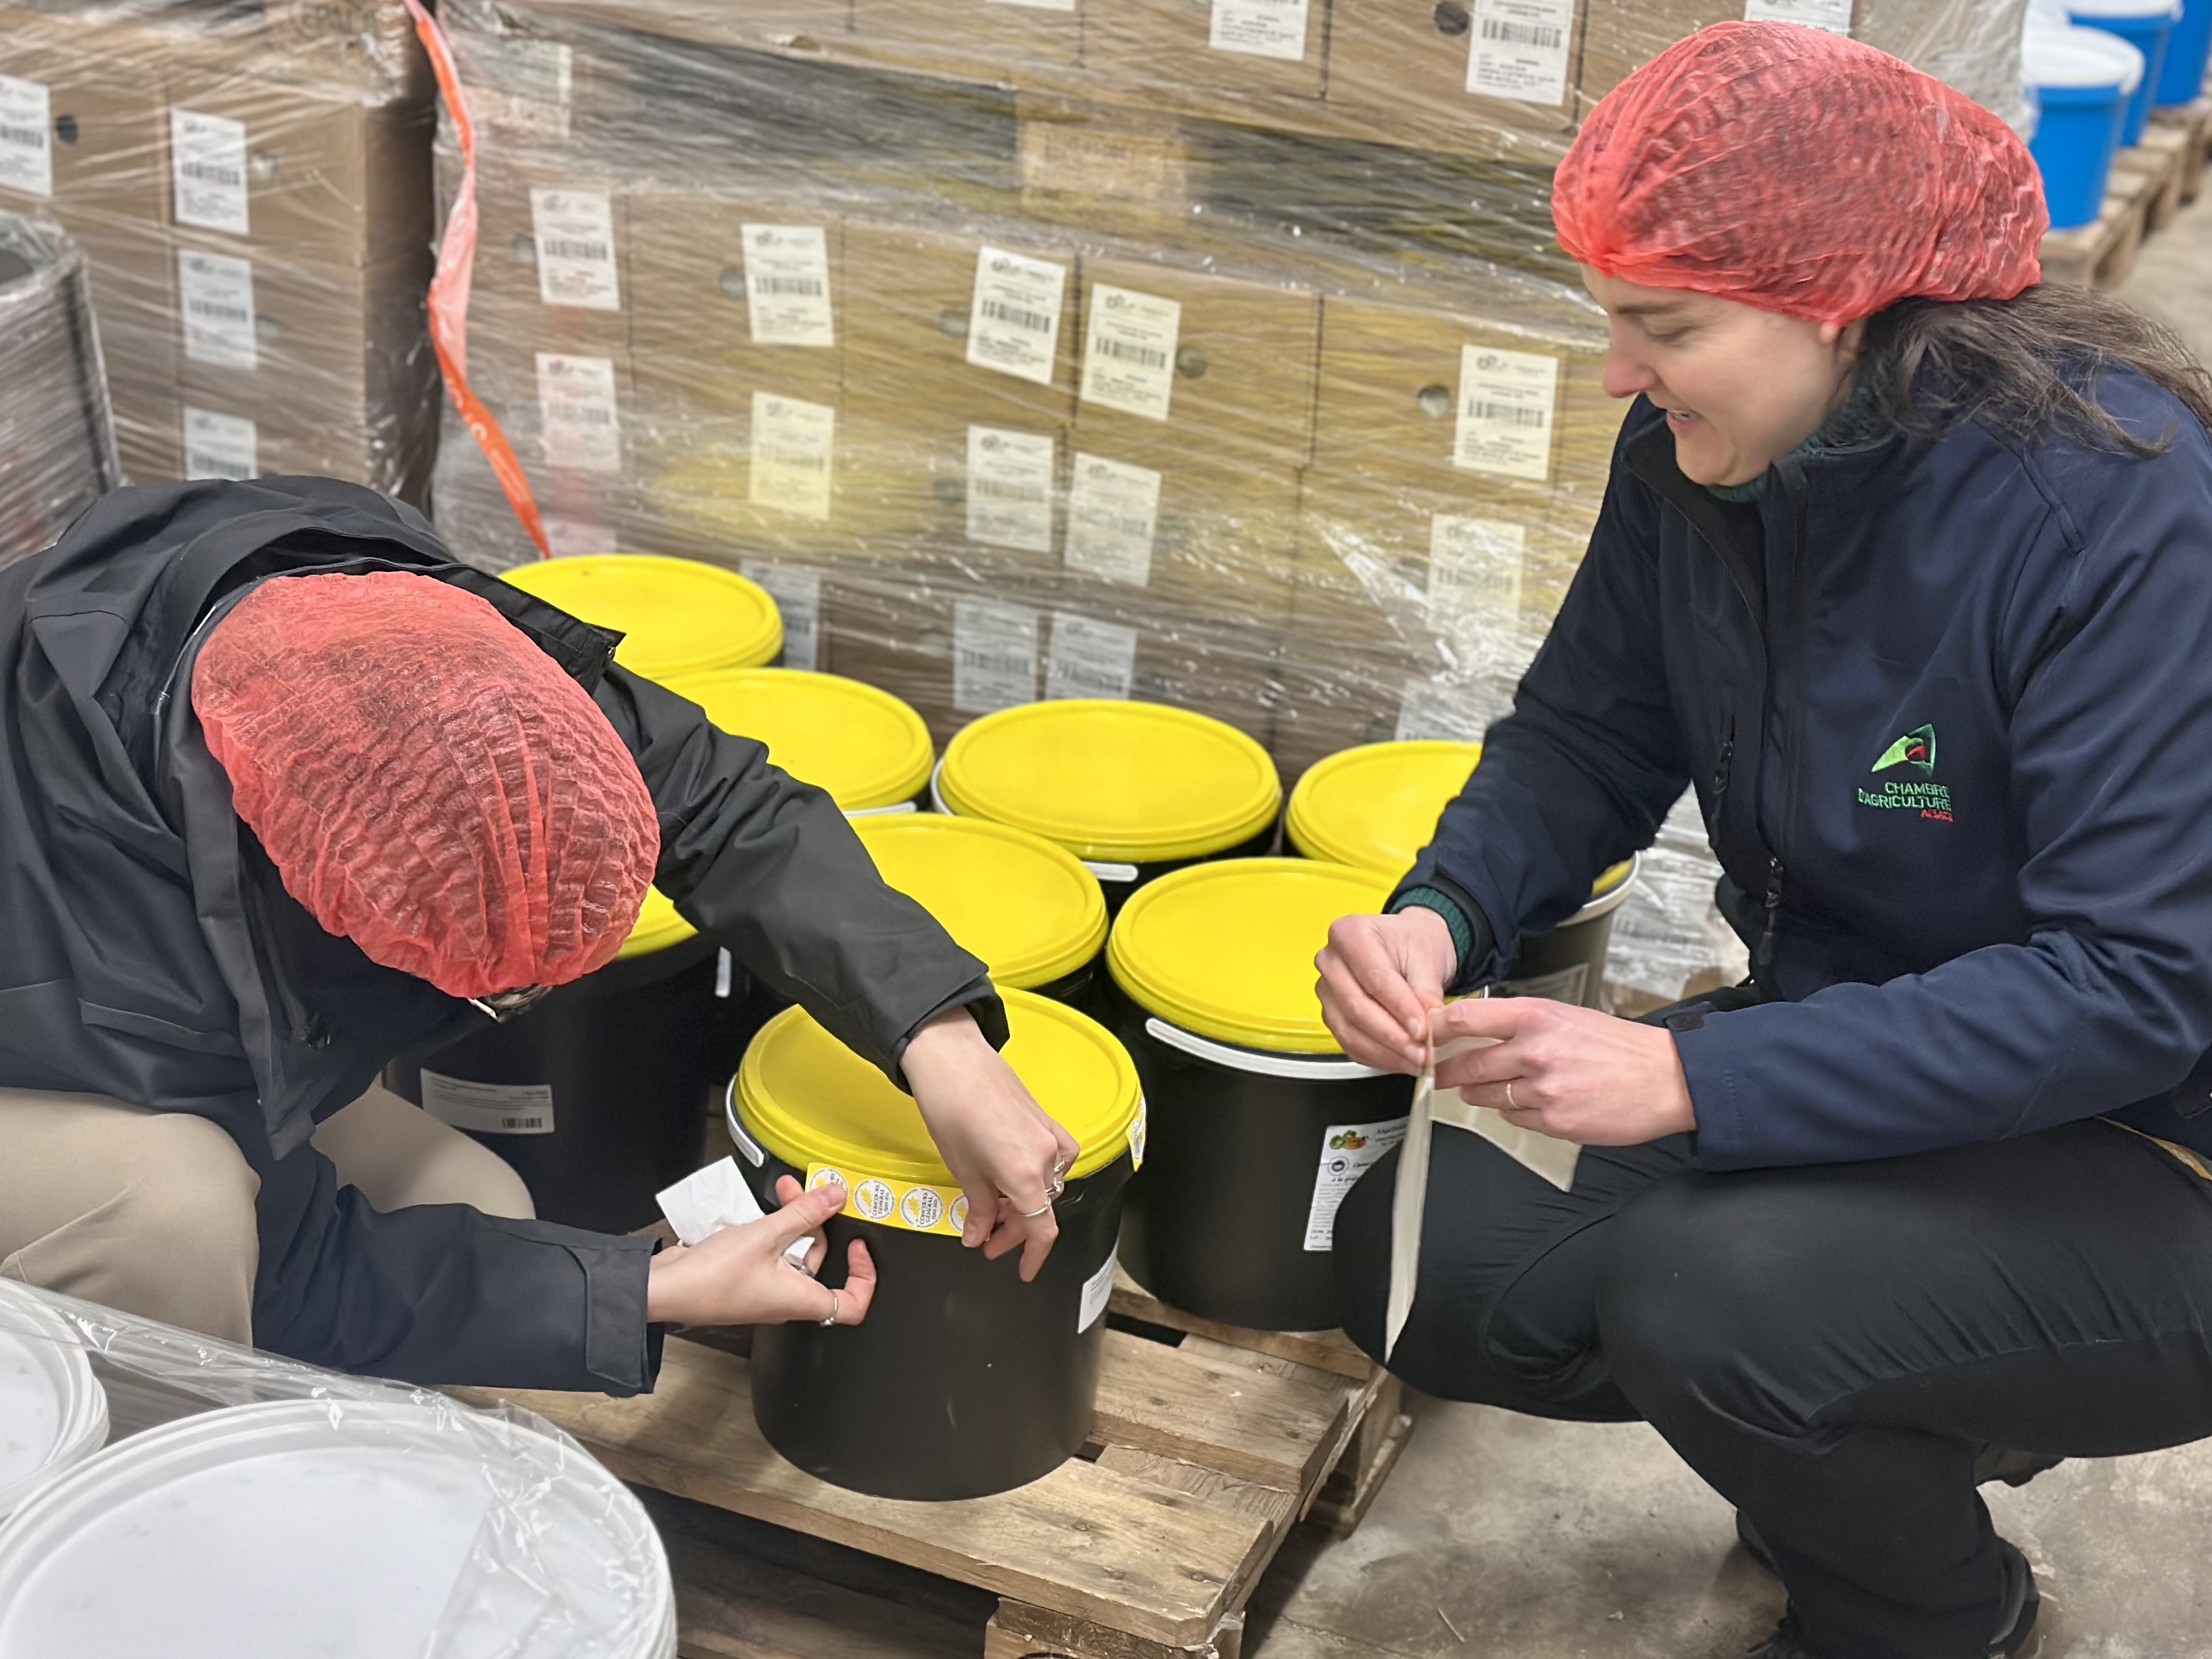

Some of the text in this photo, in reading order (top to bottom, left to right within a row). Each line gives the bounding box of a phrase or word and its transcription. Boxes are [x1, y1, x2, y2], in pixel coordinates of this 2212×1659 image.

[1858, 788, 1951, 812] D'AGRICULTURE
[1885, 782, 1950, 798] CHAMBRE
[919, 1192, 928, 1224] CONCOURS
